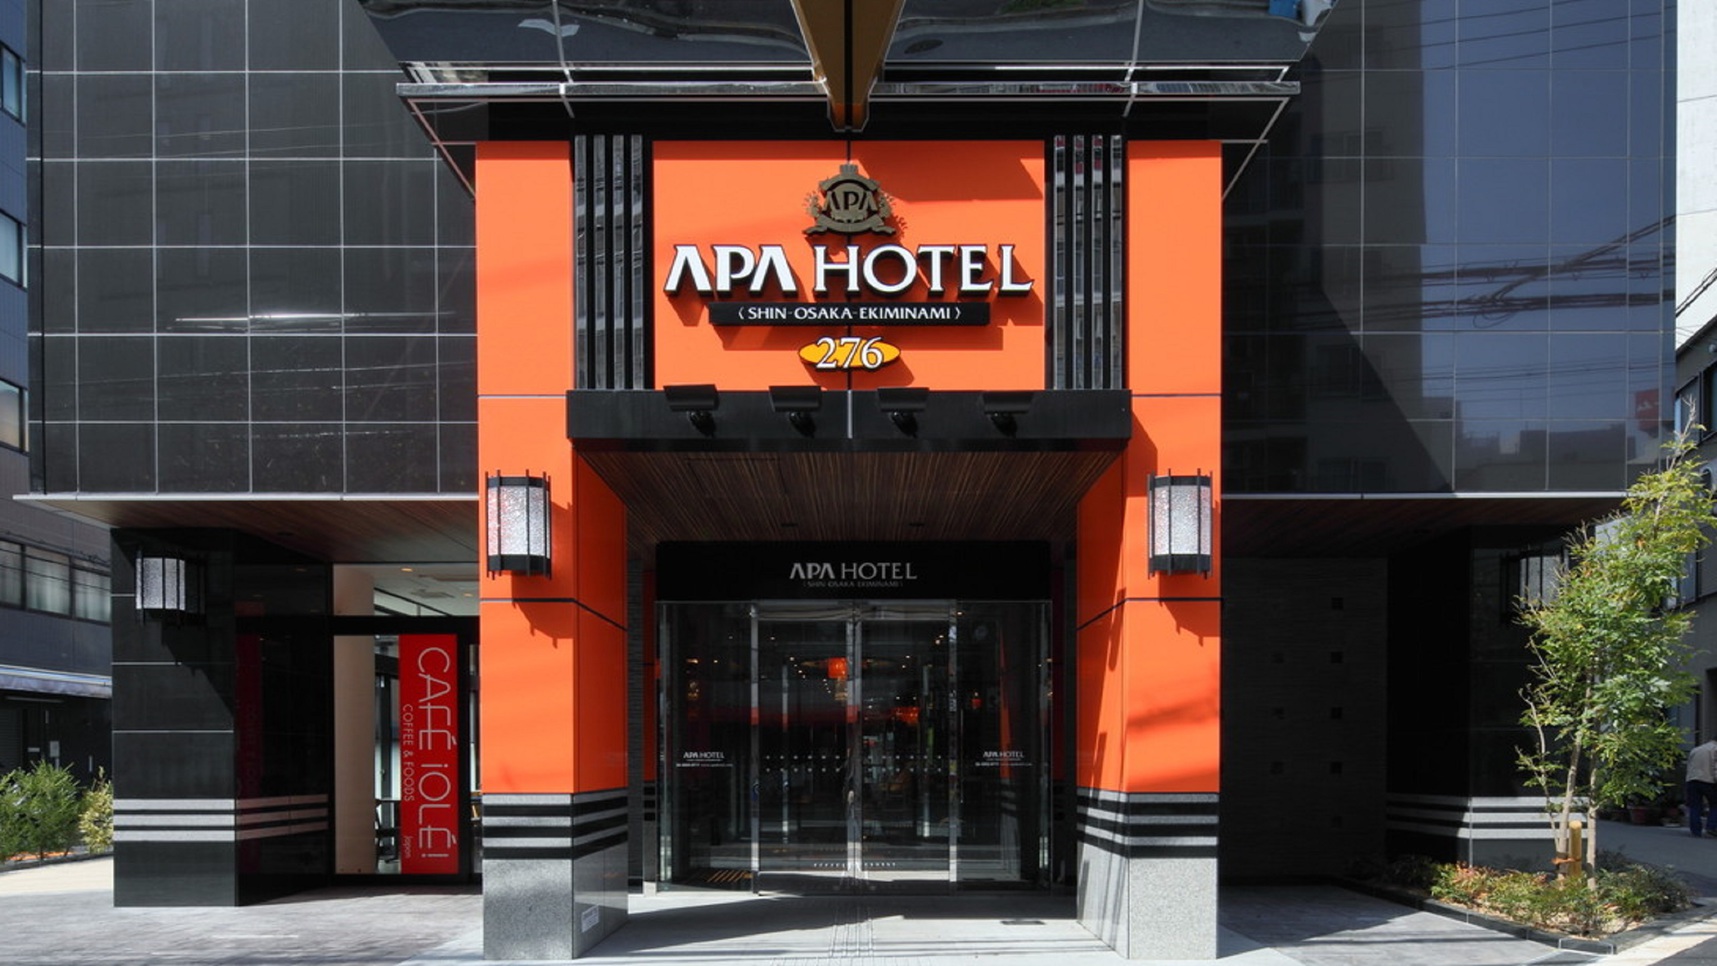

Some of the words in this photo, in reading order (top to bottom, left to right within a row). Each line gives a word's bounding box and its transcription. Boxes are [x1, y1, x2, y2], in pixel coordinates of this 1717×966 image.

[664, 244, 797, 294] APA
[814, 244, 1035, 295] HOTEL
[816, 336, 884, 369] 276
[789, 562, 836, 580] APA
[841, 562, 918, 580] HOTEL
[417, 646, 457, 751] CAFÉ
[402, 703, 414, 746] COFFEE
[402, 750, 414, 758] &
[699, 751, 725, 759] HOTEL
[999, 750, 1024, 758] HOTEL
[403, 761, 415, 802] FOODS
